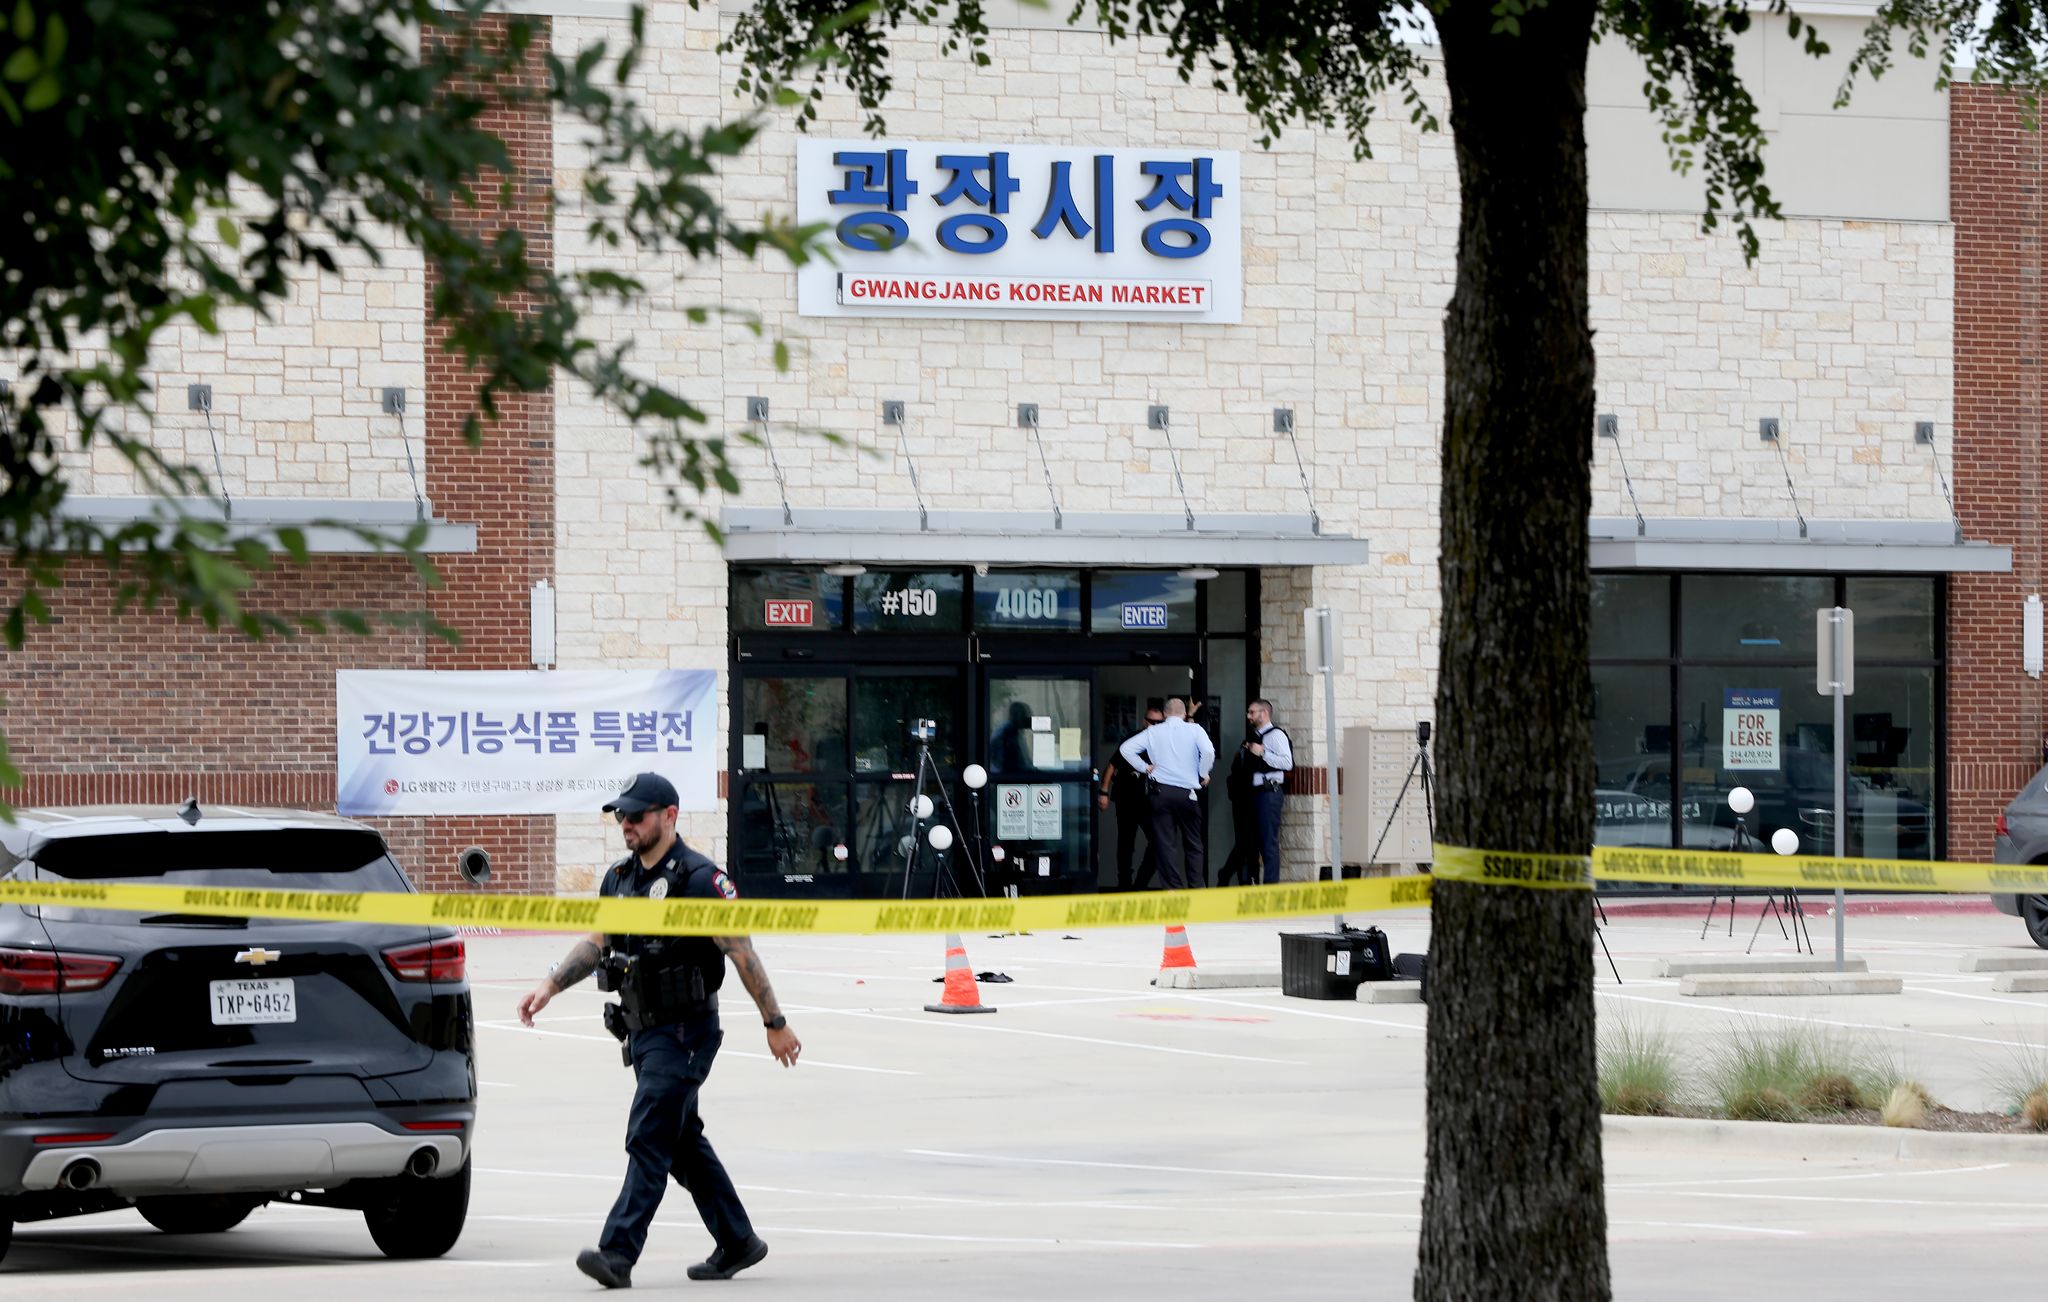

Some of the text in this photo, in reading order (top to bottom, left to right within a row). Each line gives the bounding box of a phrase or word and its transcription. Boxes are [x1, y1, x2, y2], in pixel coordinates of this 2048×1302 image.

[827, 149, 1223, 260] 광장시장
[850, 279, 1205, 305] GWANGJANG KOREAN MARKET
[768, 602, 809, 623] EXIT
[881, 588, 938, 617] #150
[994, 587, 1059, 620] 4060
[1124, 606, 1165, 625] ENTER
[362, 709, 694, 756] 건강기능식품 특별전
[1738, 713, 1765, 730] FOR
[1730, 730, 1773, 747] LEASE
[1483, 855, 1533, 881] CROSS
[236, 981, 270, 991] TEXAS
